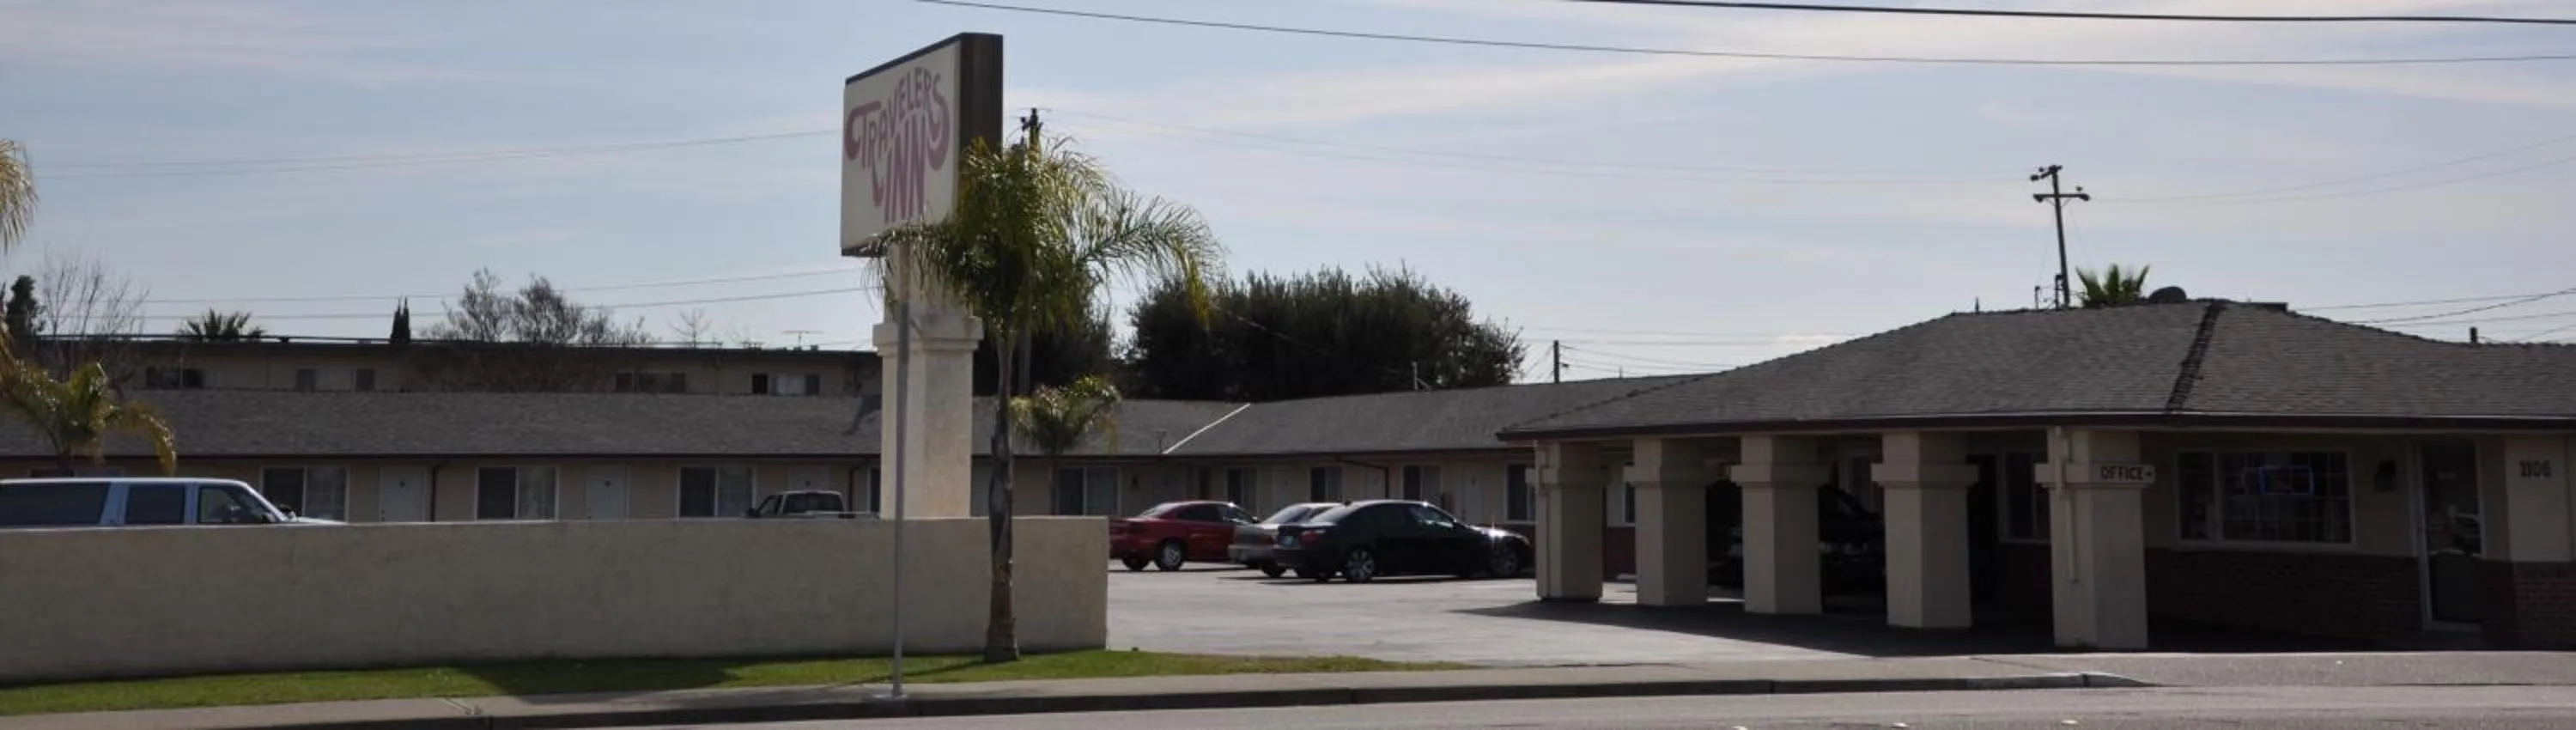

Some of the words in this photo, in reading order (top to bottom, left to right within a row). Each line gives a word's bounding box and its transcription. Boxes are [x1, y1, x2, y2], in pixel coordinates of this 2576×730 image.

[844, 67, 950, 171] TRAVELERS
[872, 113, 926, 224] INN
[2100, 465, 2144, 481] OFFICE
